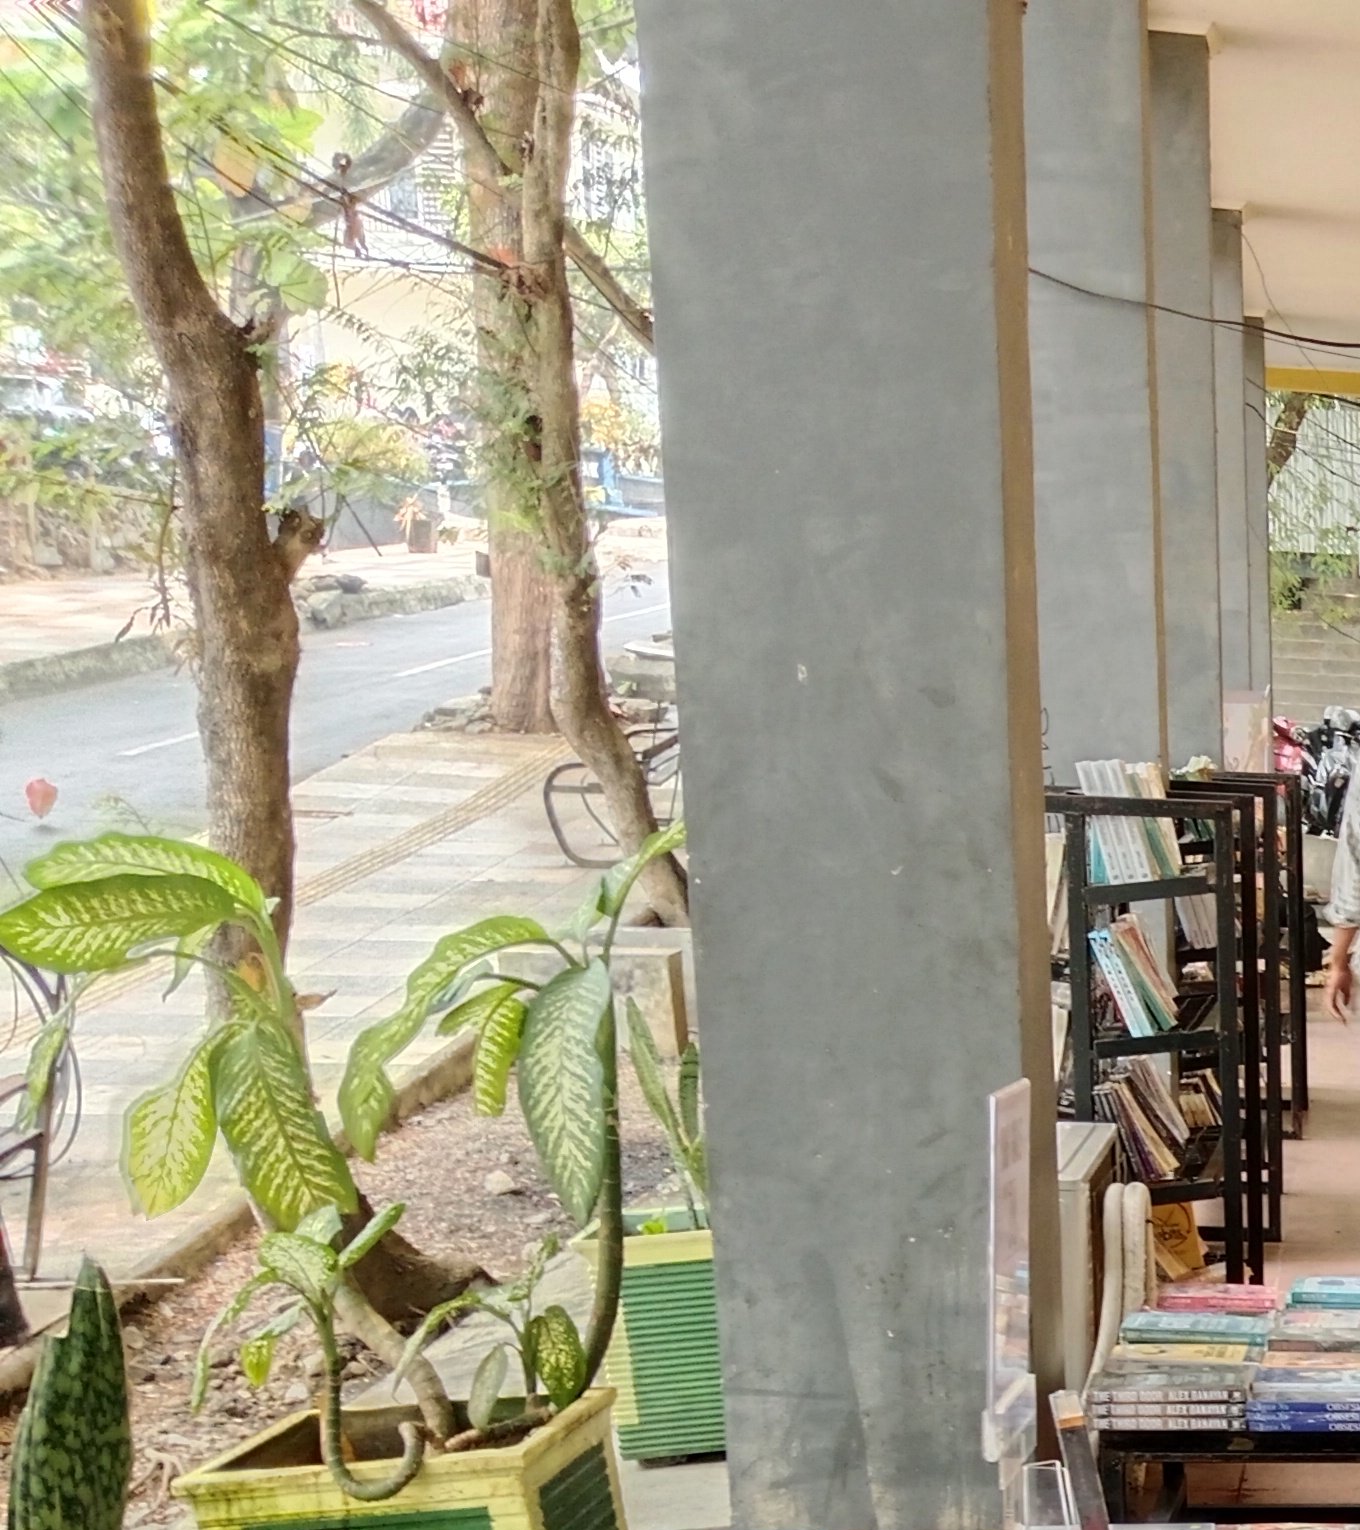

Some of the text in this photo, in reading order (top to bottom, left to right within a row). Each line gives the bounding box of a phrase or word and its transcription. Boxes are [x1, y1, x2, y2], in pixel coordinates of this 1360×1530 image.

[1166, 1390, 1190, 1402] ALEX
[1166, 1404, 1190, 1416] ALEX
[1166, 1418, 1190, 1430] ALEX
